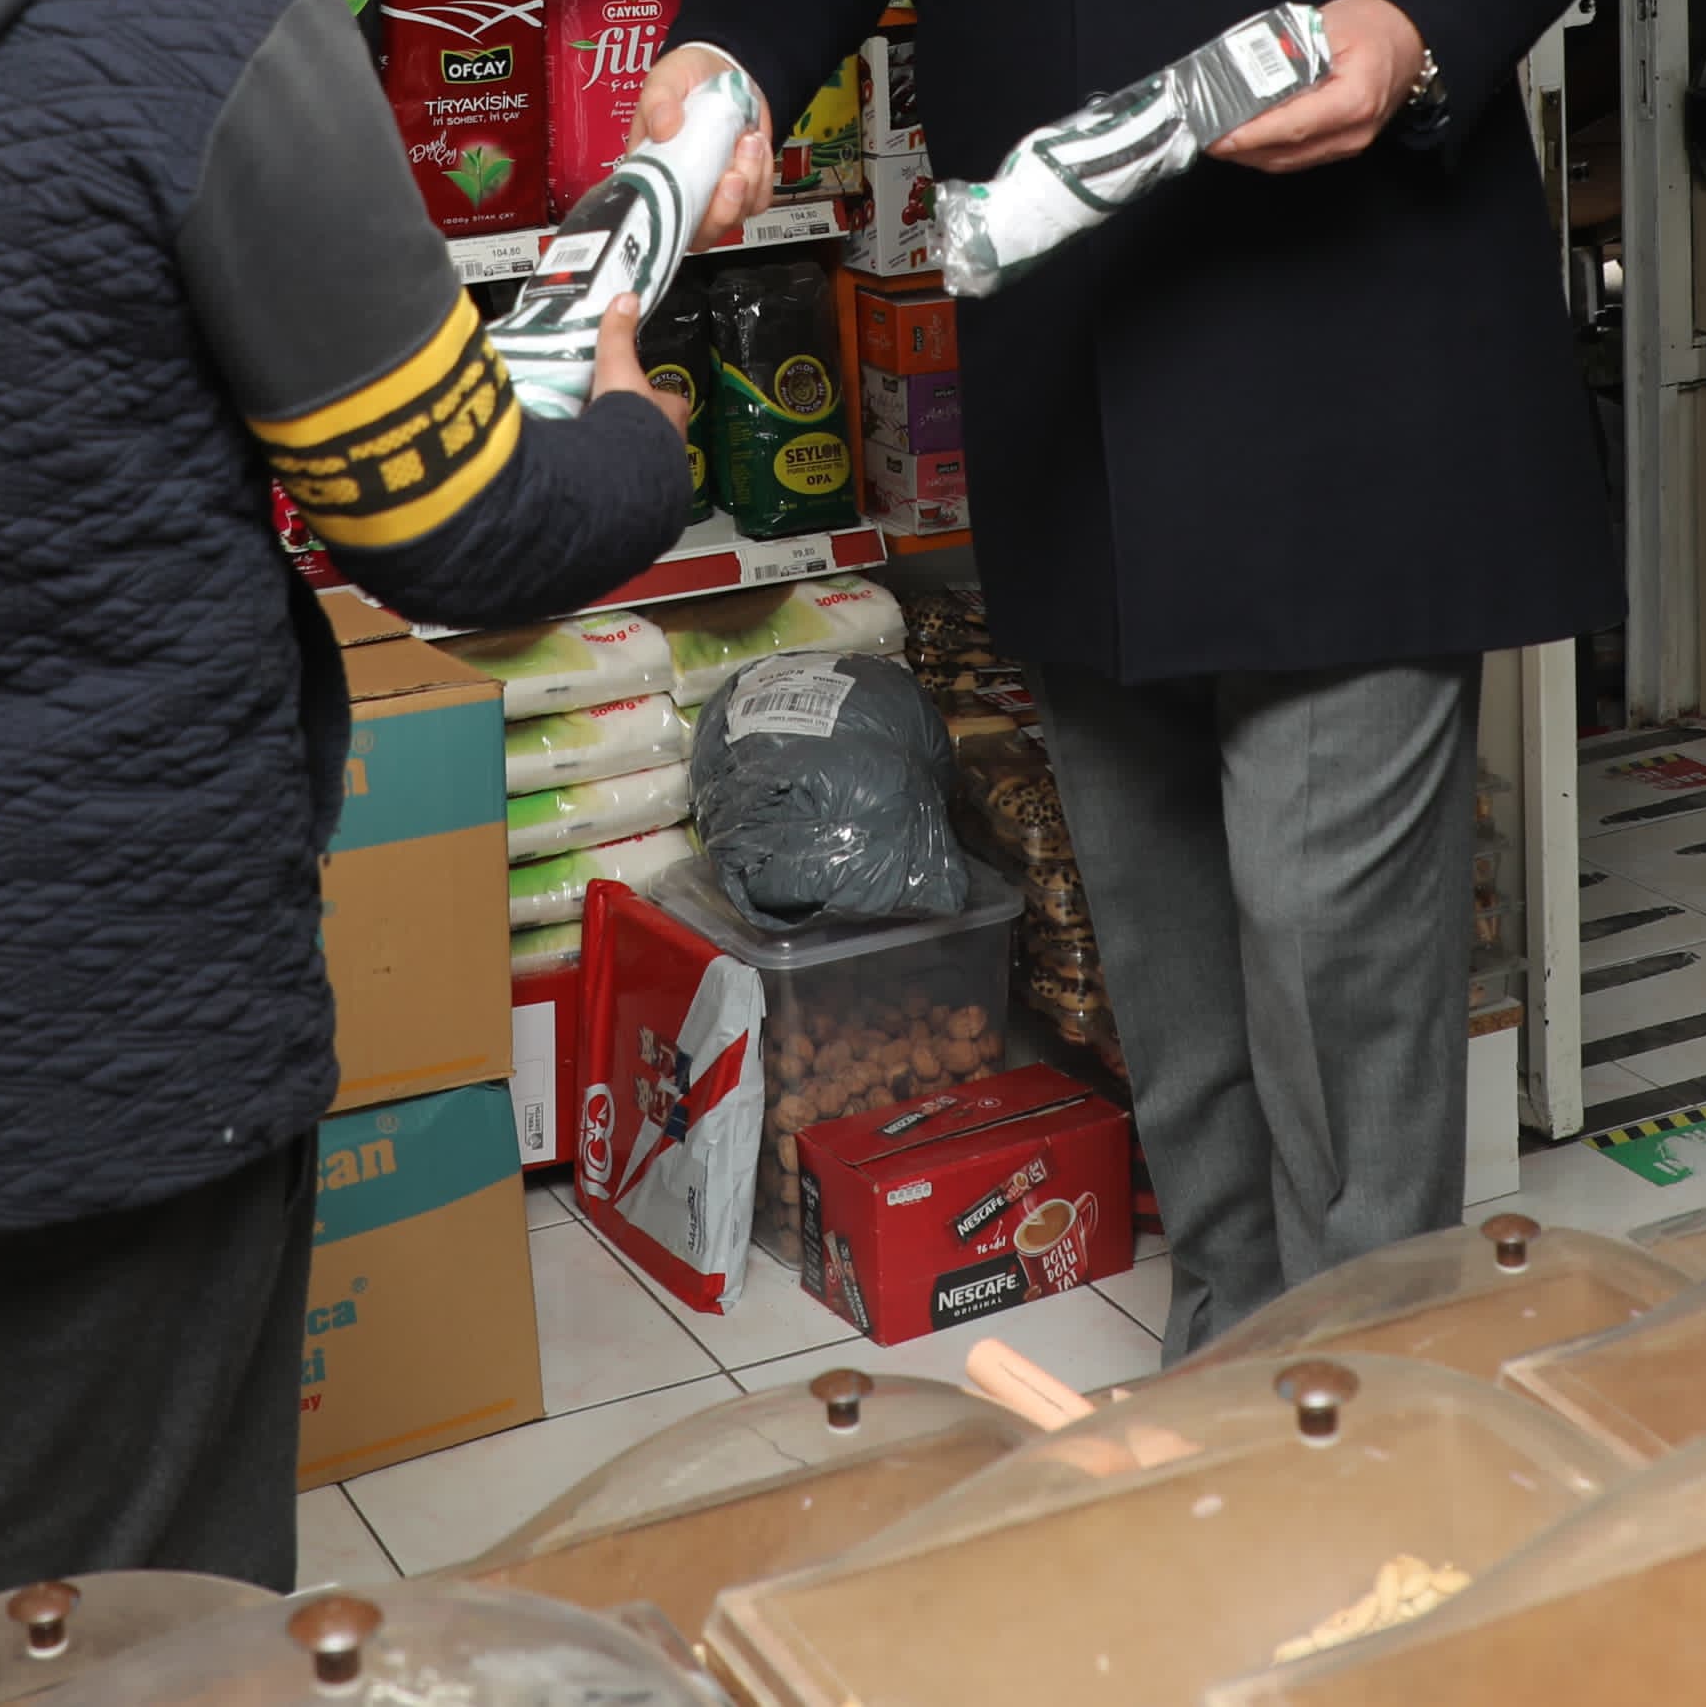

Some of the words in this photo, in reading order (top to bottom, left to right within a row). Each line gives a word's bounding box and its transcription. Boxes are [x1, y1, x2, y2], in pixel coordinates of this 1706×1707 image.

[607, 5, 658, 20] ÇAYKUR
[448, 59, 507, 79] OFÇAY
[424, 91, 529, 116] TİRYAKİSİNE
[446, 114, 486, 126] SOHBET,
[502, 112, 521, 123] ÇAY
[805, 473, 832, 486] OPA
[1041, 1237, 1073, 1270] DOLU
[1046, 1249, 1079, 1284] DOLU
[1054, 1268, 1079, 1292] TAT
